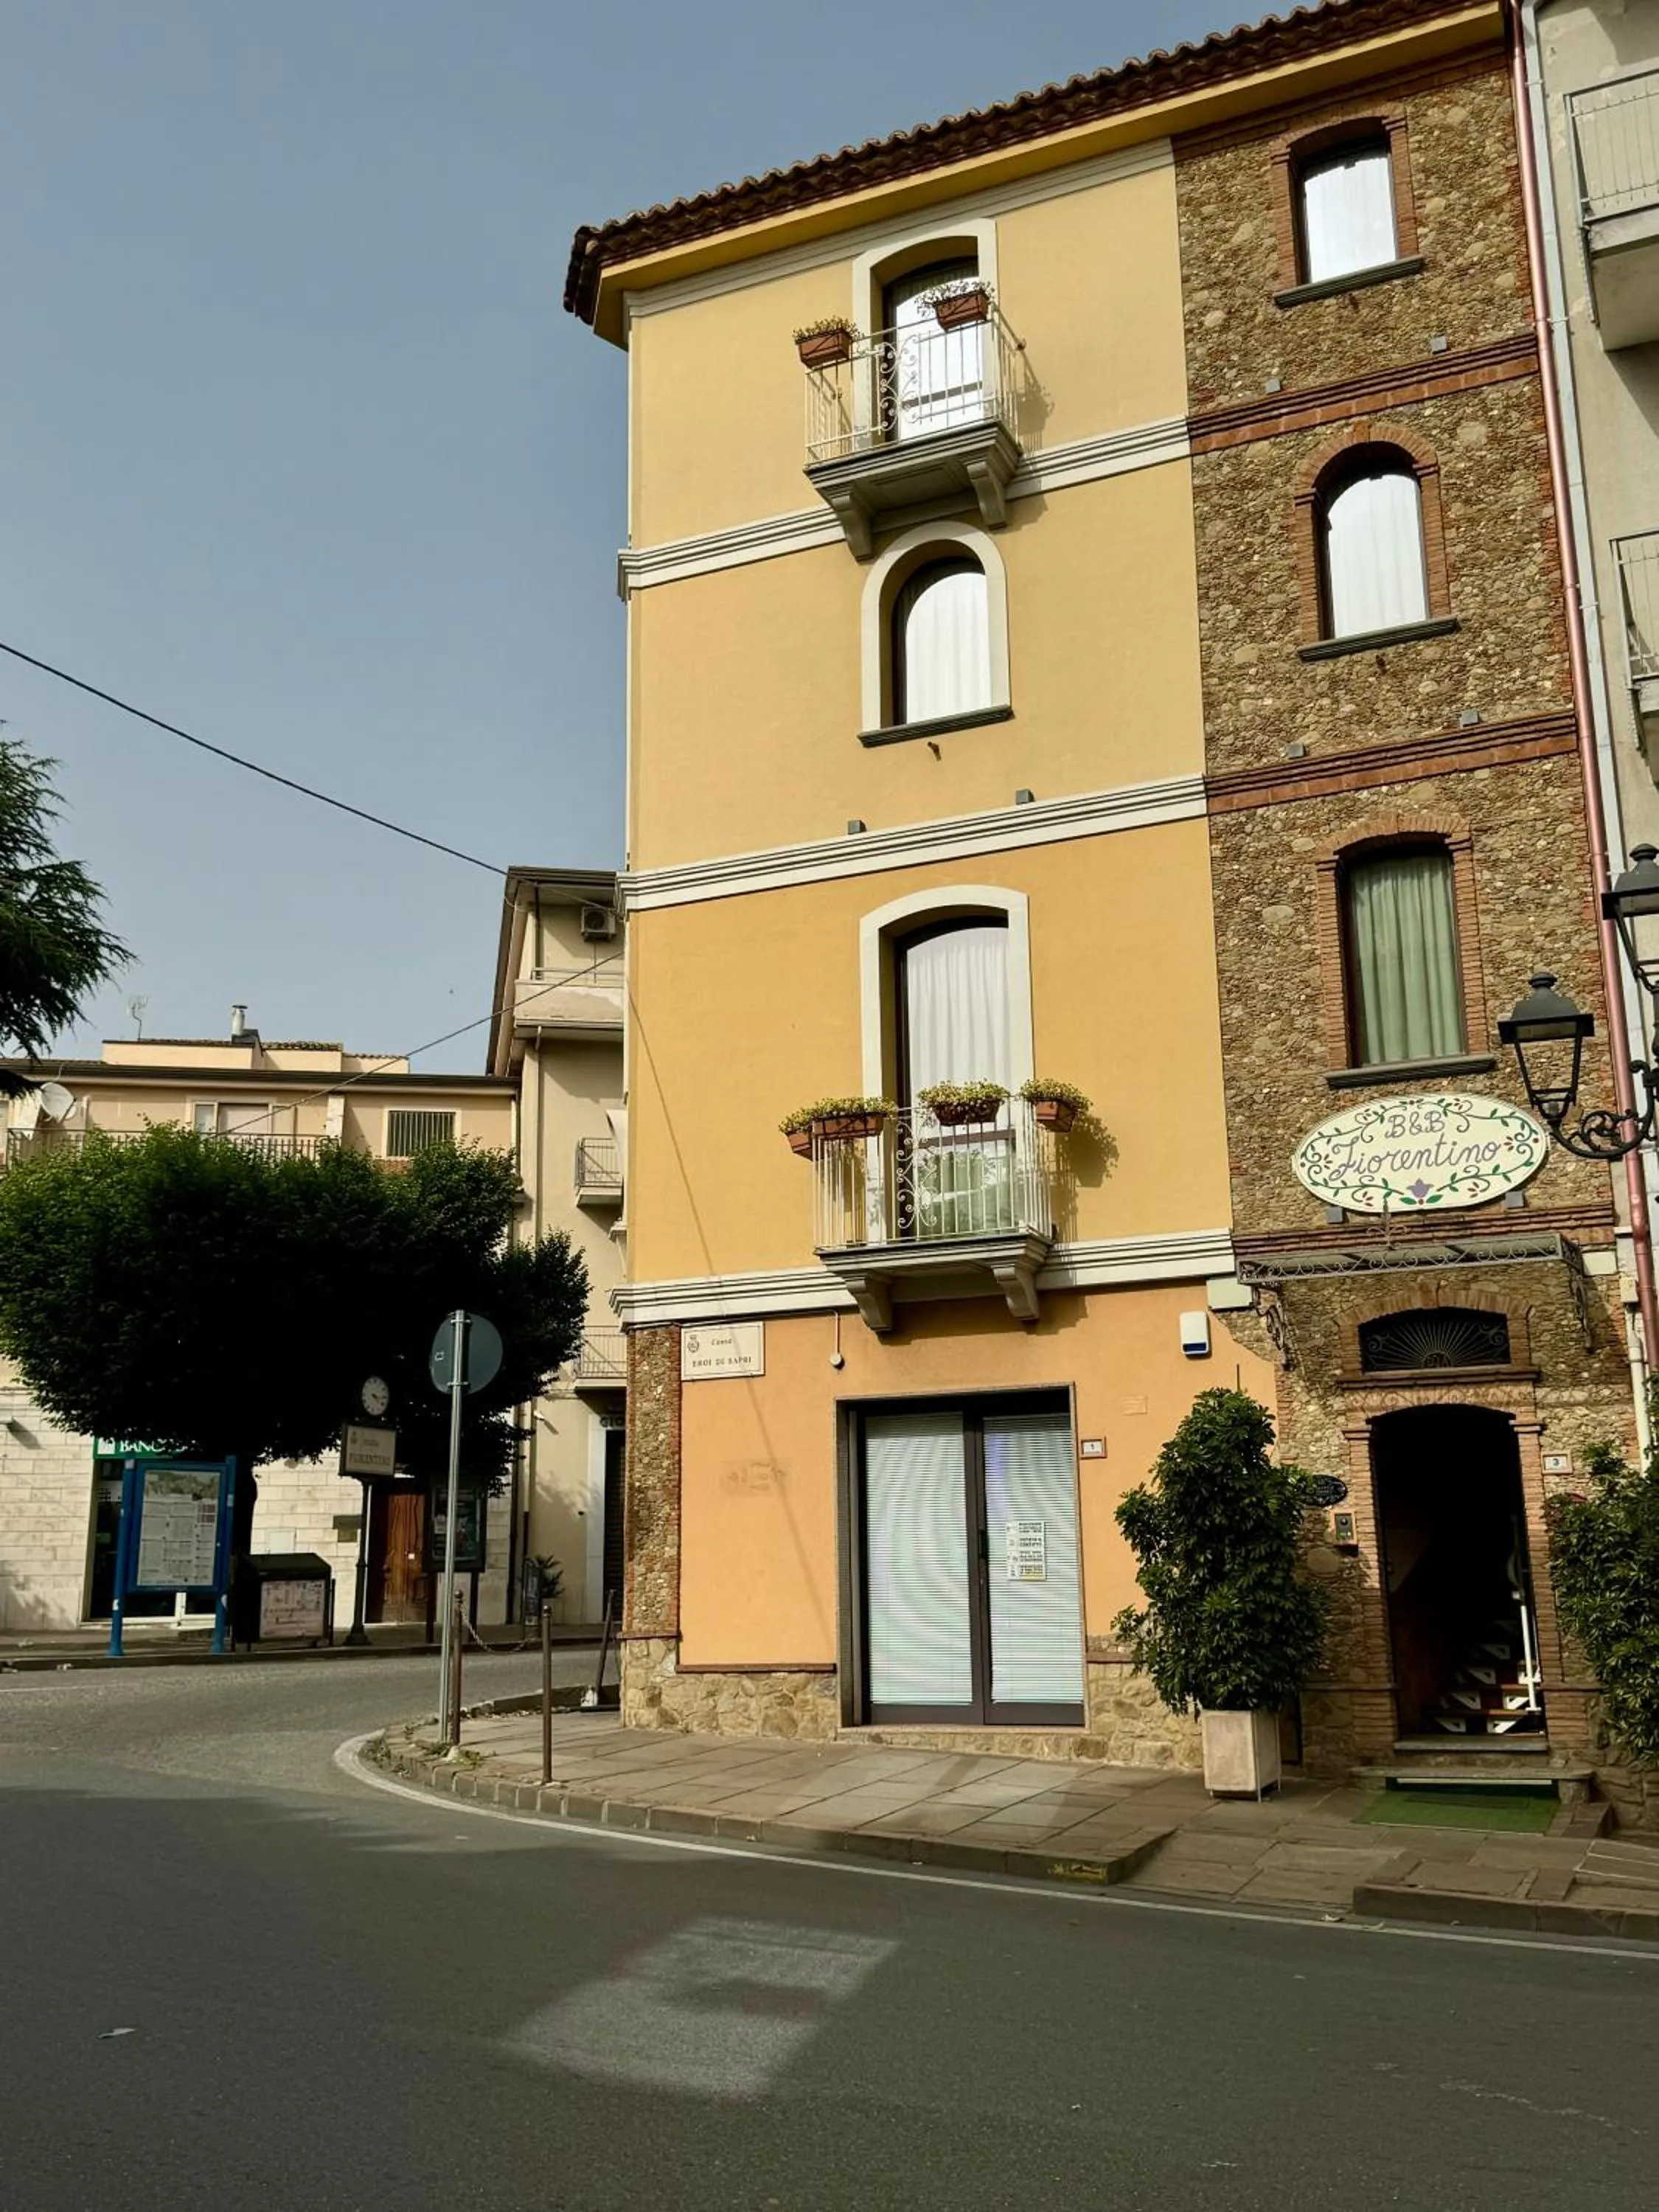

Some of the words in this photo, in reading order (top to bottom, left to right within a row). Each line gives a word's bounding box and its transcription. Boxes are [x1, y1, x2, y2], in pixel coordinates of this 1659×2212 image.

[1384, 1110, 1445, 1138] B&B
[1328, 1133, 1501, 1181] Fiorentino
[1553, 1458, 1559, 1466] 3
